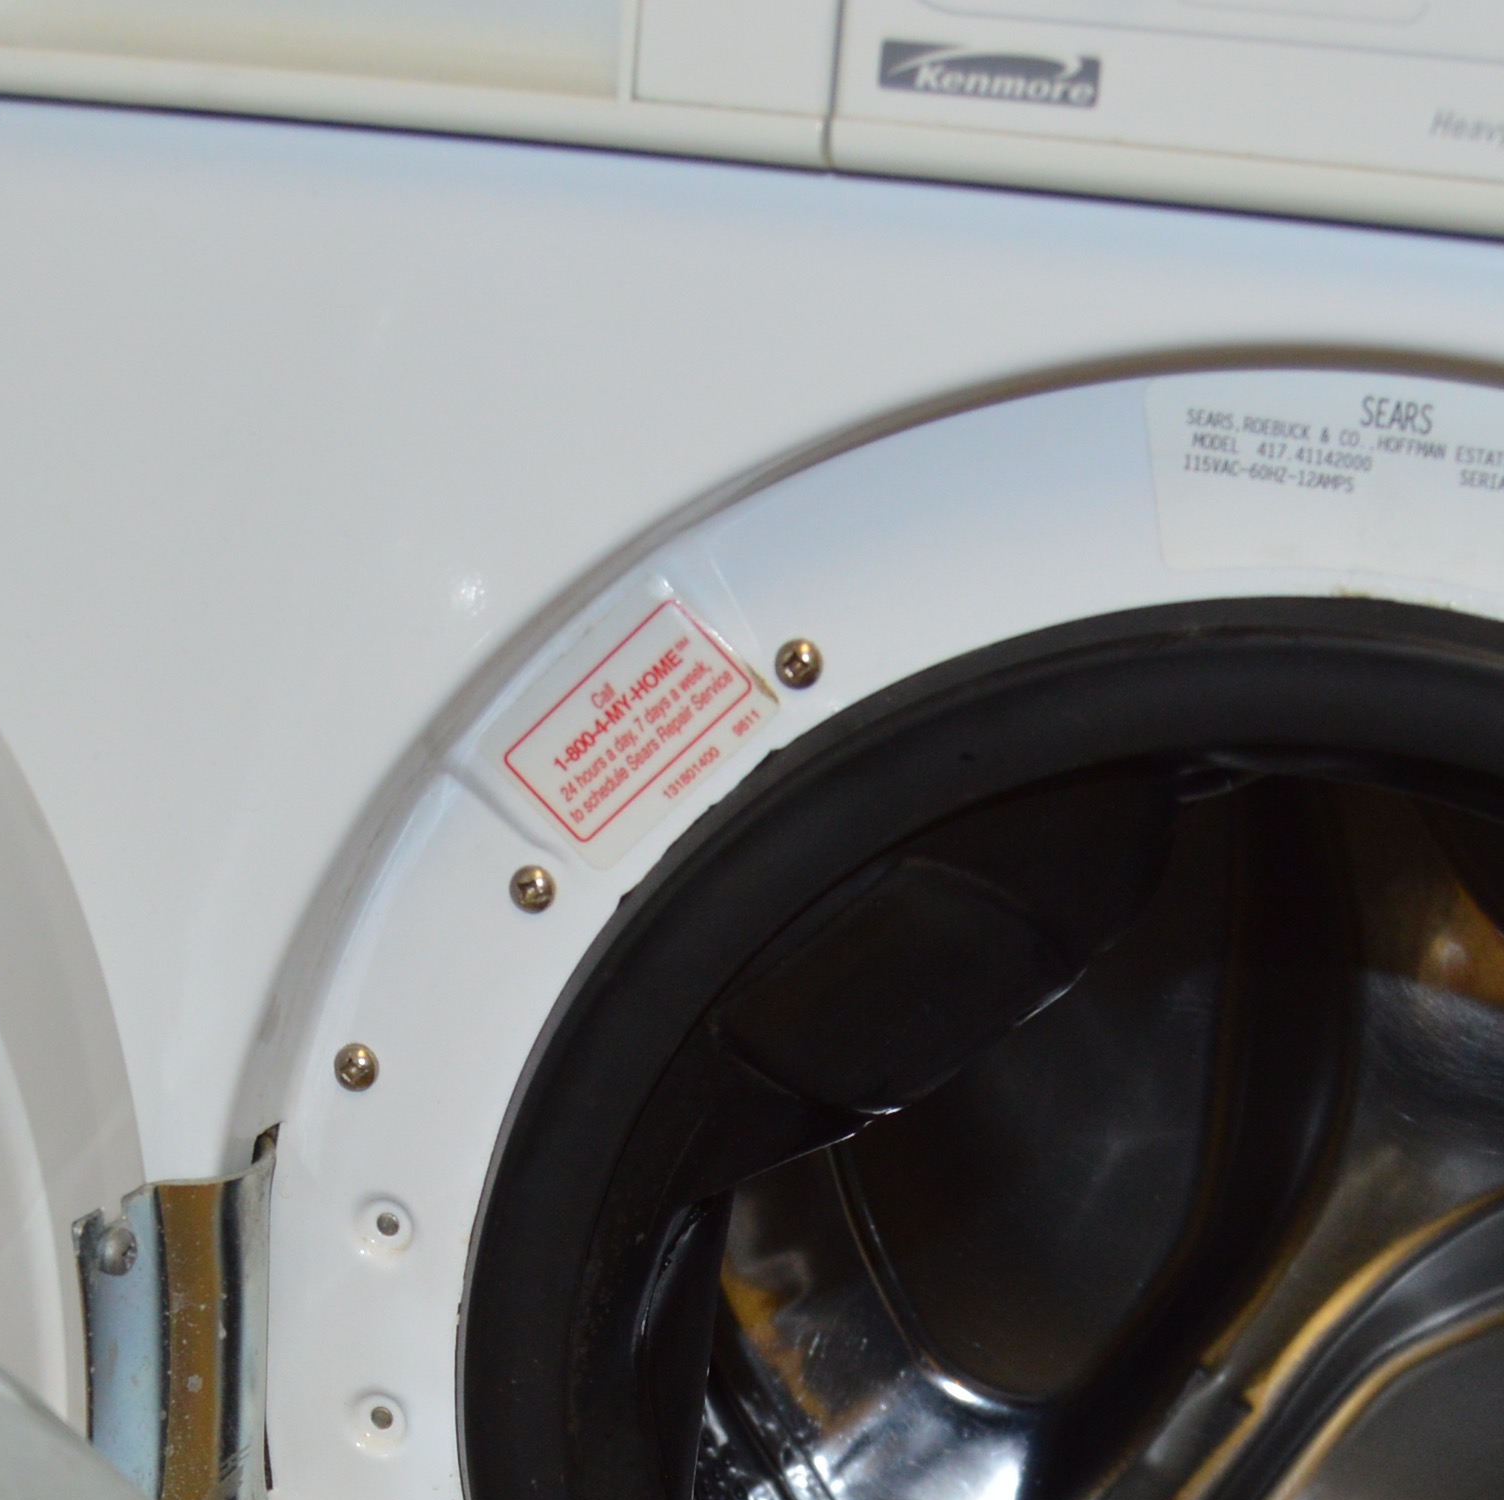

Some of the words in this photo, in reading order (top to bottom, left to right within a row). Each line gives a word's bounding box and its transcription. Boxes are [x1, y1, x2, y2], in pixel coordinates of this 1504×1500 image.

[914, 64, 1094, 104] Kenmore
[1319, 425, 1331, 444] &
[1360, 395, 1434, 434] SEARS
[1192, 432, 1239, 454] MODEL
[1256, 441, 1372, 473] 417.41142000
[591, 682, 616, 709] Call
[560, 781, 578, 803] 24
[574, 756, 607, 789] hours
[605, 748, 617, 762] a
[633, 716, 645, 733] 7
[644, 696, 672, 725] days
[669, 688, 681, 702] a
[570, 808, 585, 824] to
[582, 766, 630, 813] schedule
[626, 738, 661, 772] Sears
[656, 706, 694, 743] Repair
[690, 670, 734, 711] Service
